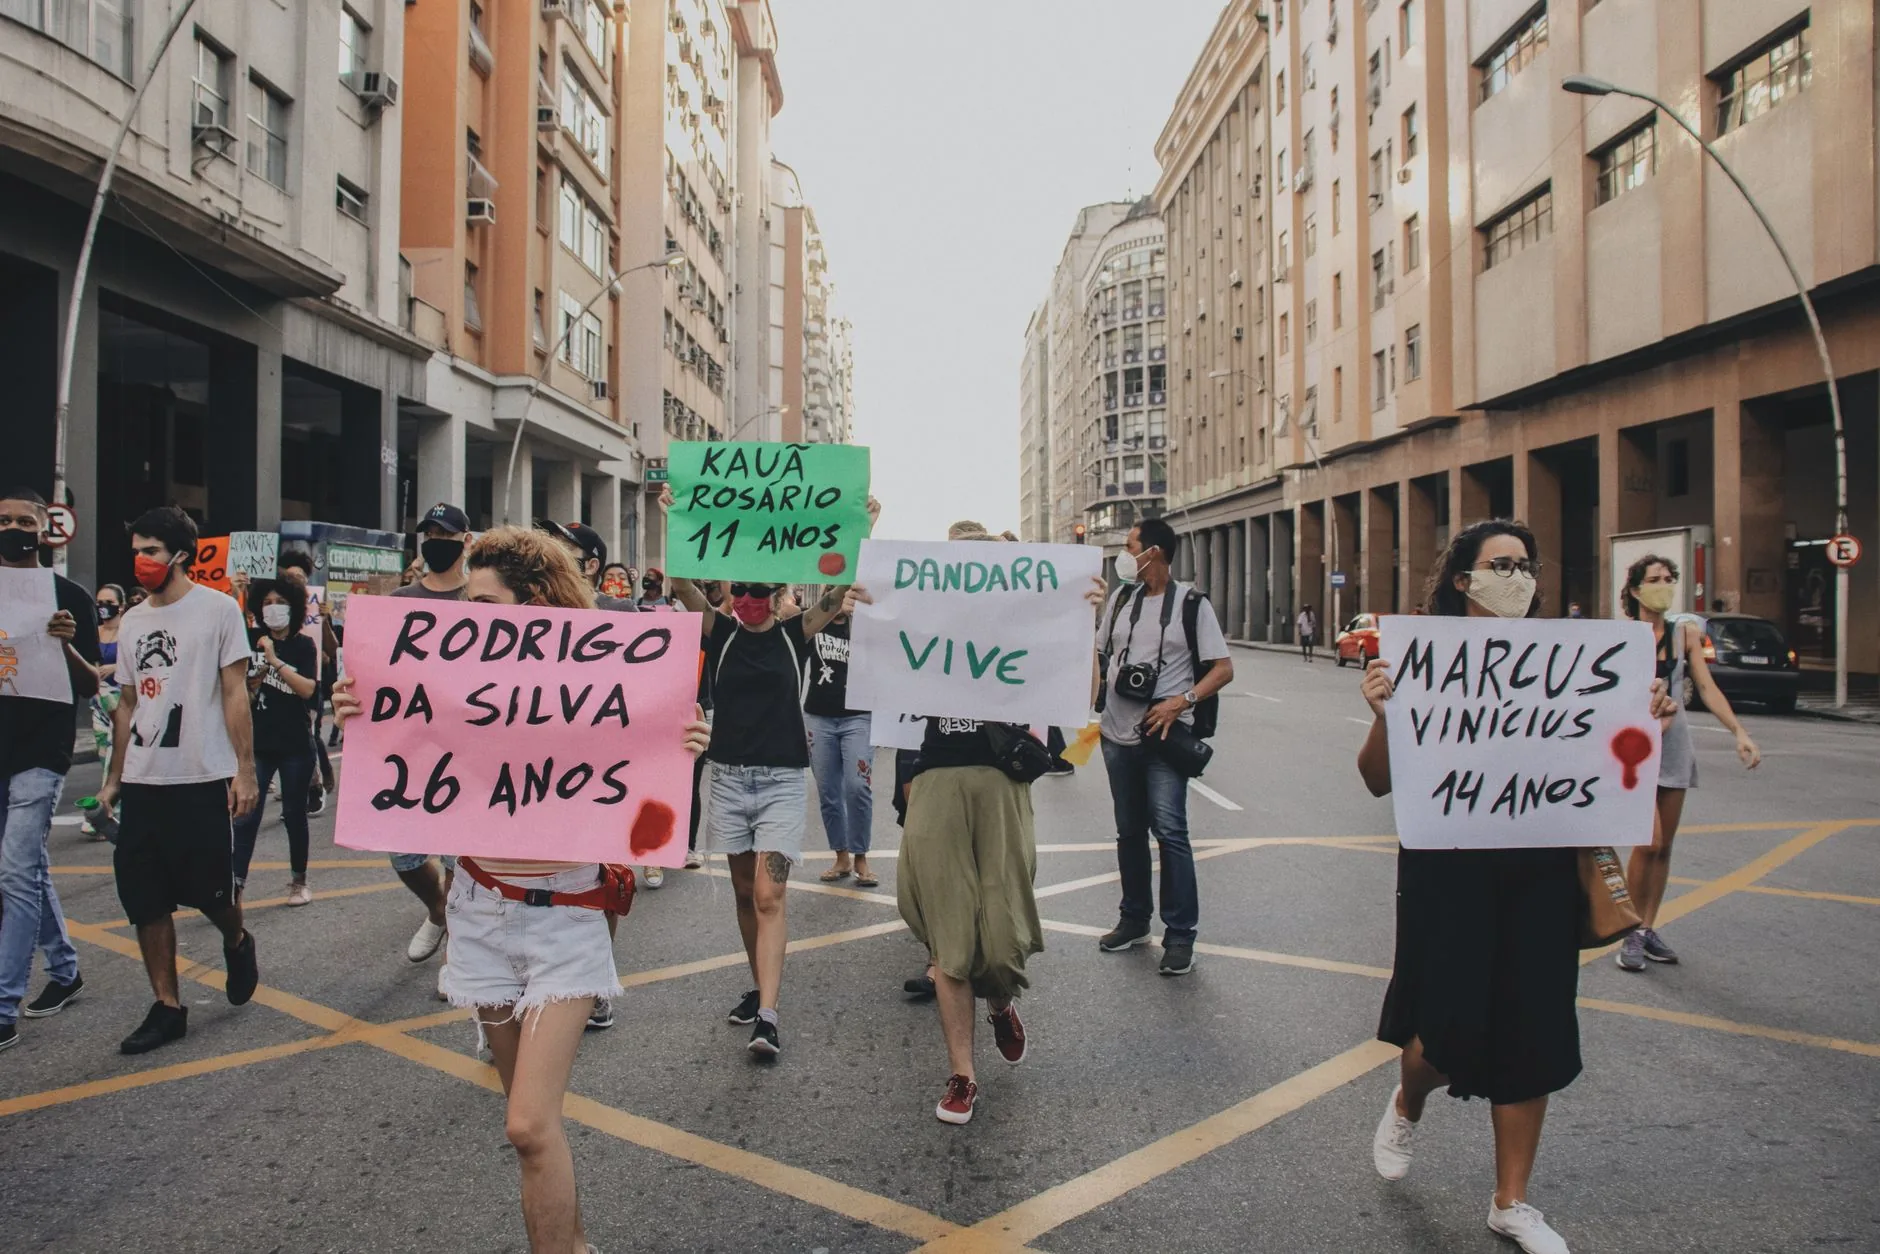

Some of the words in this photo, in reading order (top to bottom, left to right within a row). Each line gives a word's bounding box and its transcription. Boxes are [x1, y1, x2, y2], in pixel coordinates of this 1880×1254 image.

[700, 443, 804, 481] KAUÃ
[687, 479, 841, 513] ROSÁRIO
[687, 520, 740, 560] 11
[757, 522, 841, 554] ANOS
[896, 556, 1059, 594] DANDARA
[389, 611, 671, 666] RODRIGO
[899, 631, 1029, 686] VIVE
[1391, 637, 1627, 701] MARCUS
[371, 683, 433, 724] DA
[465, 683, 630, 729] SILVA
[1411, 699, 1595, 746] VINÍCIUS
[370, 751, 460, 815] 26
[488, 756, 630, 818] ANOS
[1432, 769, 1483, 816] 14
[1490, 774, 1600, 819] ANOS
